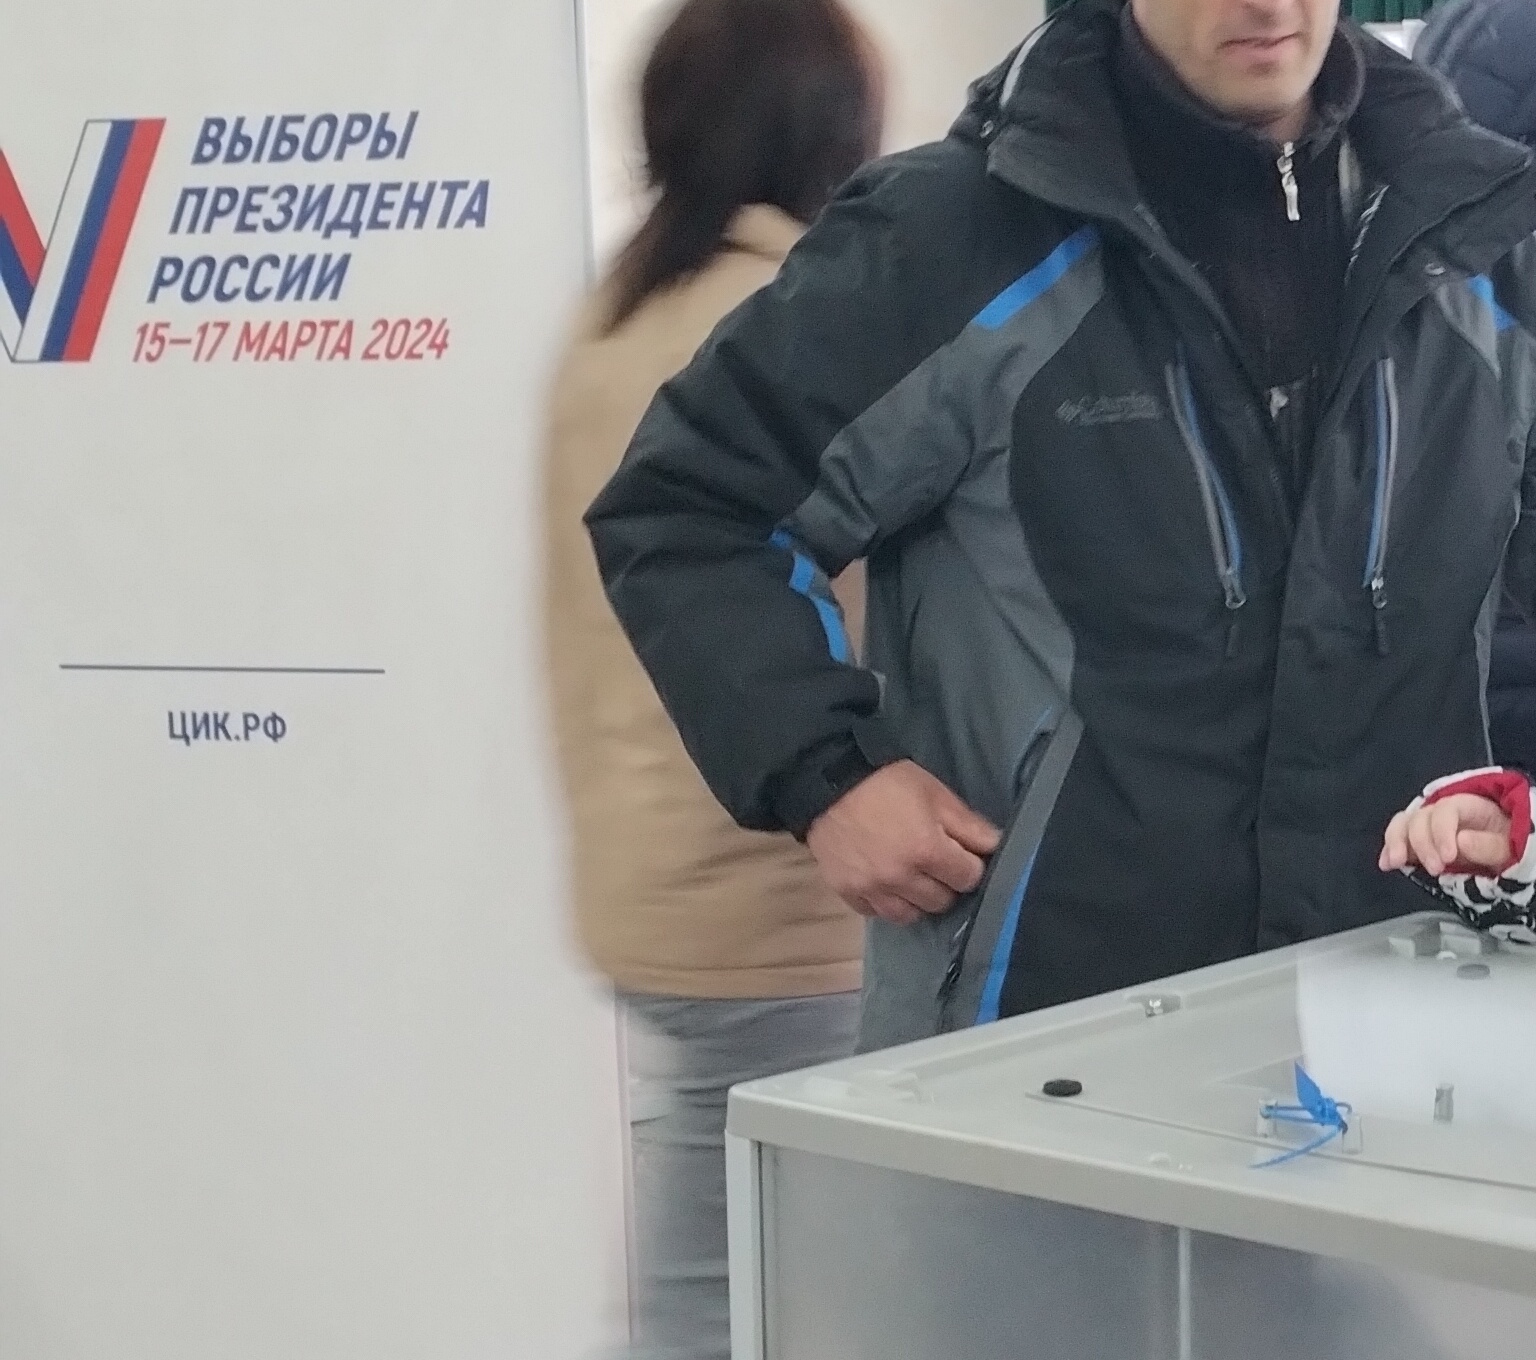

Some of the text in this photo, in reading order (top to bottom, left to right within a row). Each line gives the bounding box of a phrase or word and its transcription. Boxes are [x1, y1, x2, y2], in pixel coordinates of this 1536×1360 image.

[191, 111, 419, 165] ВЫБОРЫ
[169, 180, 490, 239] ПРЕЗИДЕНТА
[147, 253, 351, 303] РОССИИ
[232, 320, 354, 362] МАРТА
[361, 318, 450, 360] 2024
[168, 711, 287, 745] ЦИК.РФ
